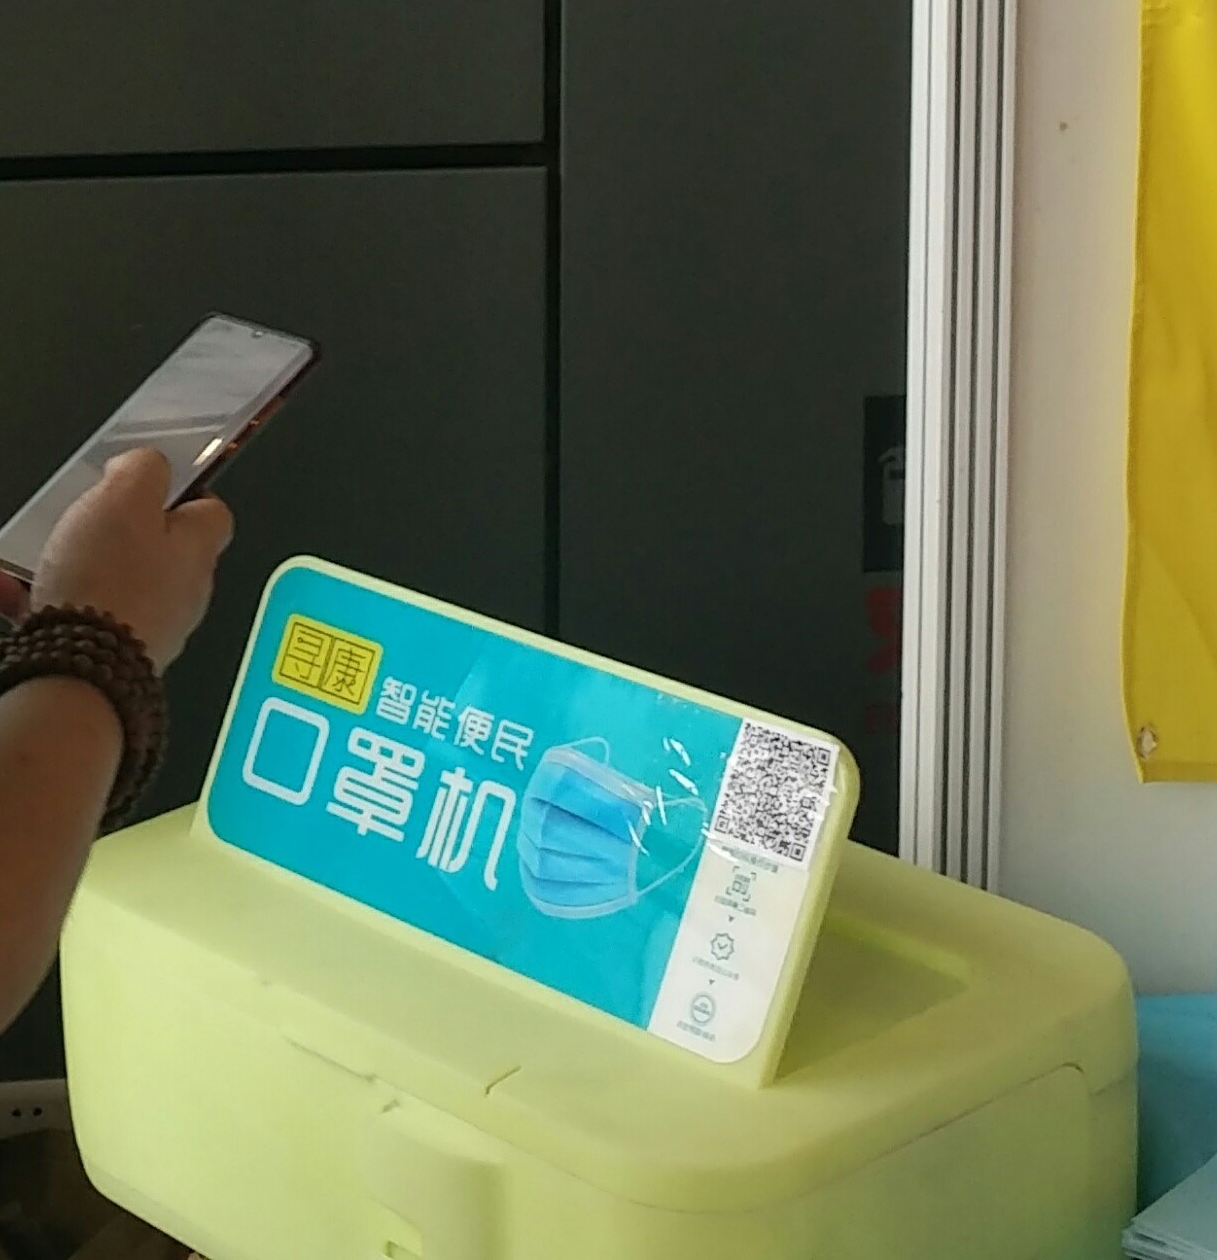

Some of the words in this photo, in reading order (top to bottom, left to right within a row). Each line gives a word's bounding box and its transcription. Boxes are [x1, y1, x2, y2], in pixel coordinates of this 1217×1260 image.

[241, 696, 517, 892] 口罩机
[376, 676, 535, 771] 智能便民
